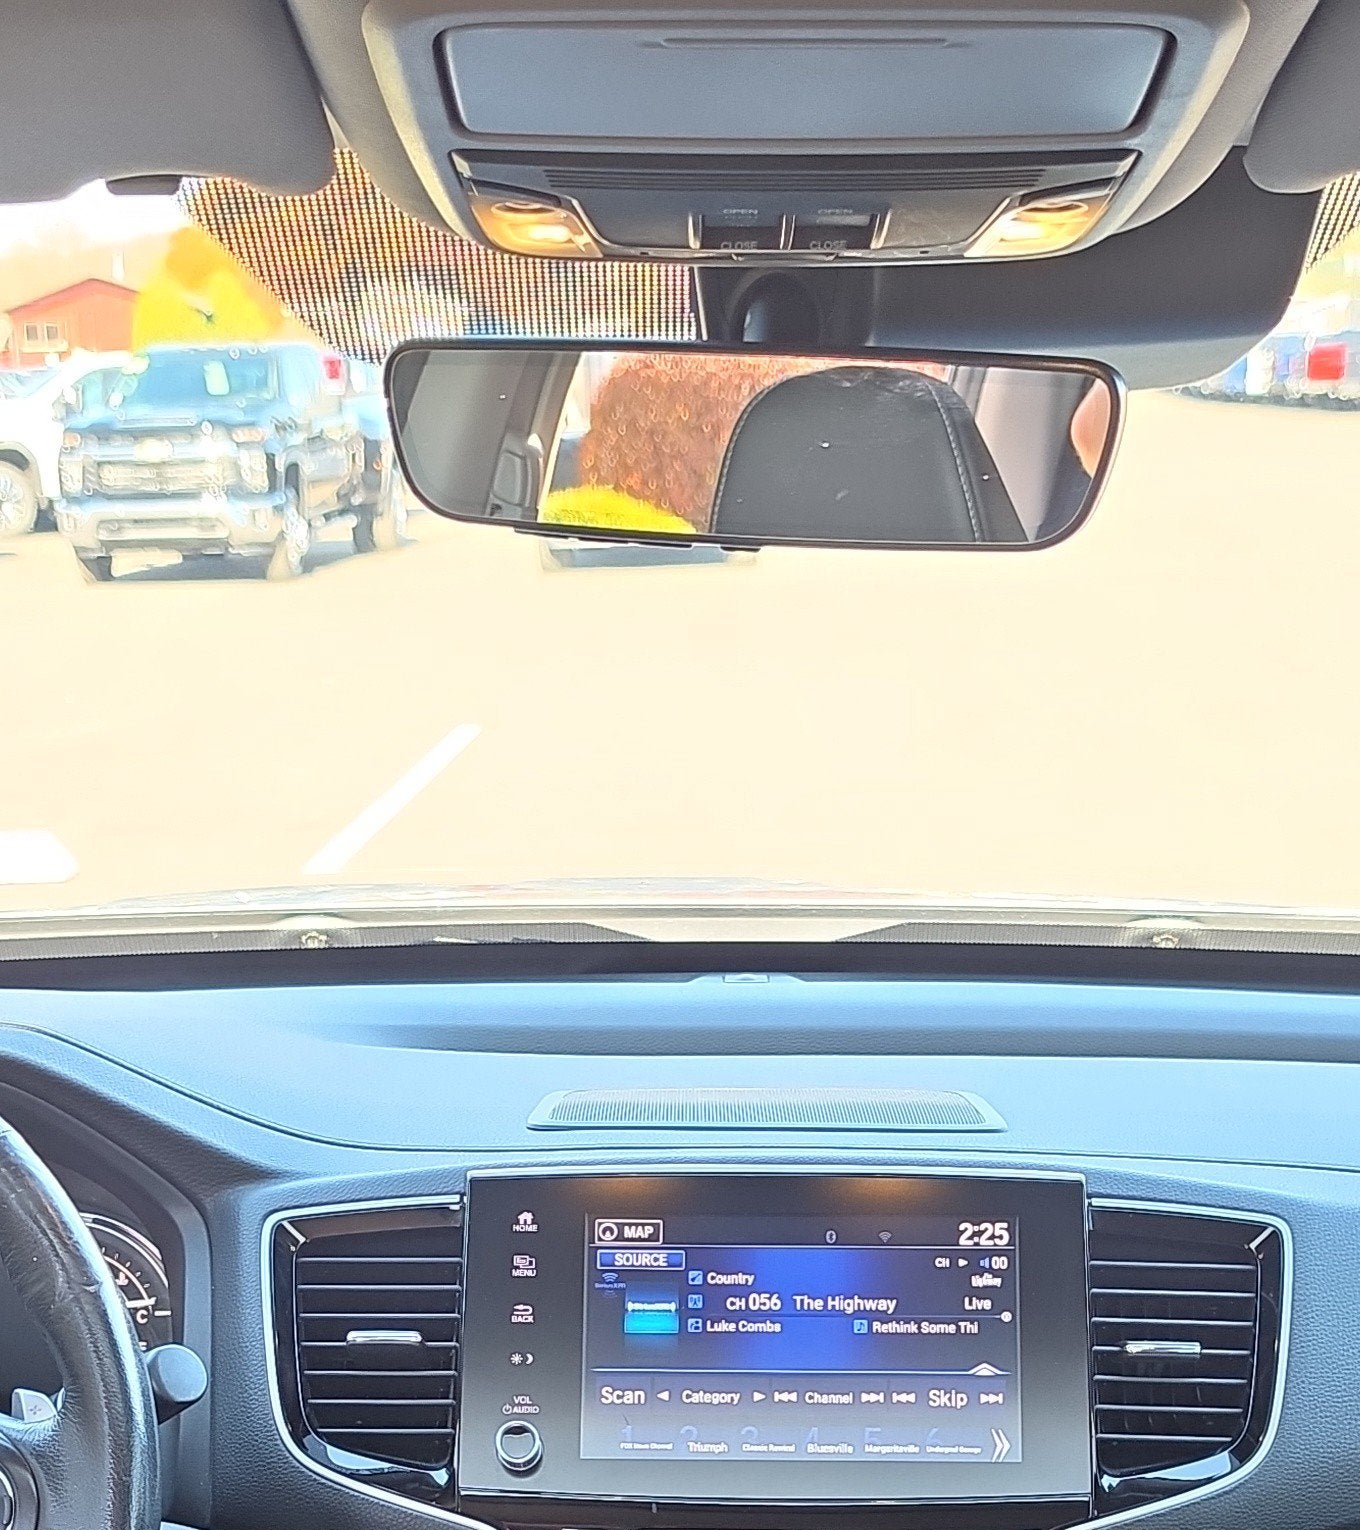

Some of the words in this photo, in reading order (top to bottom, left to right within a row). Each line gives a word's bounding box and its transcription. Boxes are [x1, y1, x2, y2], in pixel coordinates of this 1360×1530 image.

[512, 1224, 538, 1232] HOME
[623, 1225, 655, 1239] MAP
[958, 1222, 1011, 1246] 2:25
[614, 1253, 669, 1266] SOURCE
[934, 1257, 951, 1269] CH
[511, 1269, 537, 1277] MENU
[706, 1272, 755, 1287] Country
[726, 1297, 746, 1311] CH
[748, 1293, 782, 1311] 056
[792, 1295, 824, 1311] The
[827, 1295, 898, 1315] Highway
[964, 1296, 993, 1311] Live
[136, 1309, 149, 1324] C
[511, 1315, 534, 1323] BACK
[706, 1320, 737, 1333] Luke
[738, 1319, 782, 1333] Combs
[872, 1321, 919, 1335] Rethink
[920, 1321, 957, 1335] Some
[958, 1321, 979, 1335] Thi
[513, 1395, 532, 1405] VOL
[600, 1386, 646, 1405] Scan
[681, 1389, 741, 1406] Category
[804, 1391, 854, 1405] Channel
[928, 1389, 968, 1410] Skip
[512, 1405, 540, 1414] AUDIO
[687, 1441, 729, 1455] Triumph
[806, 1442, 854, 1454] Bluesville
